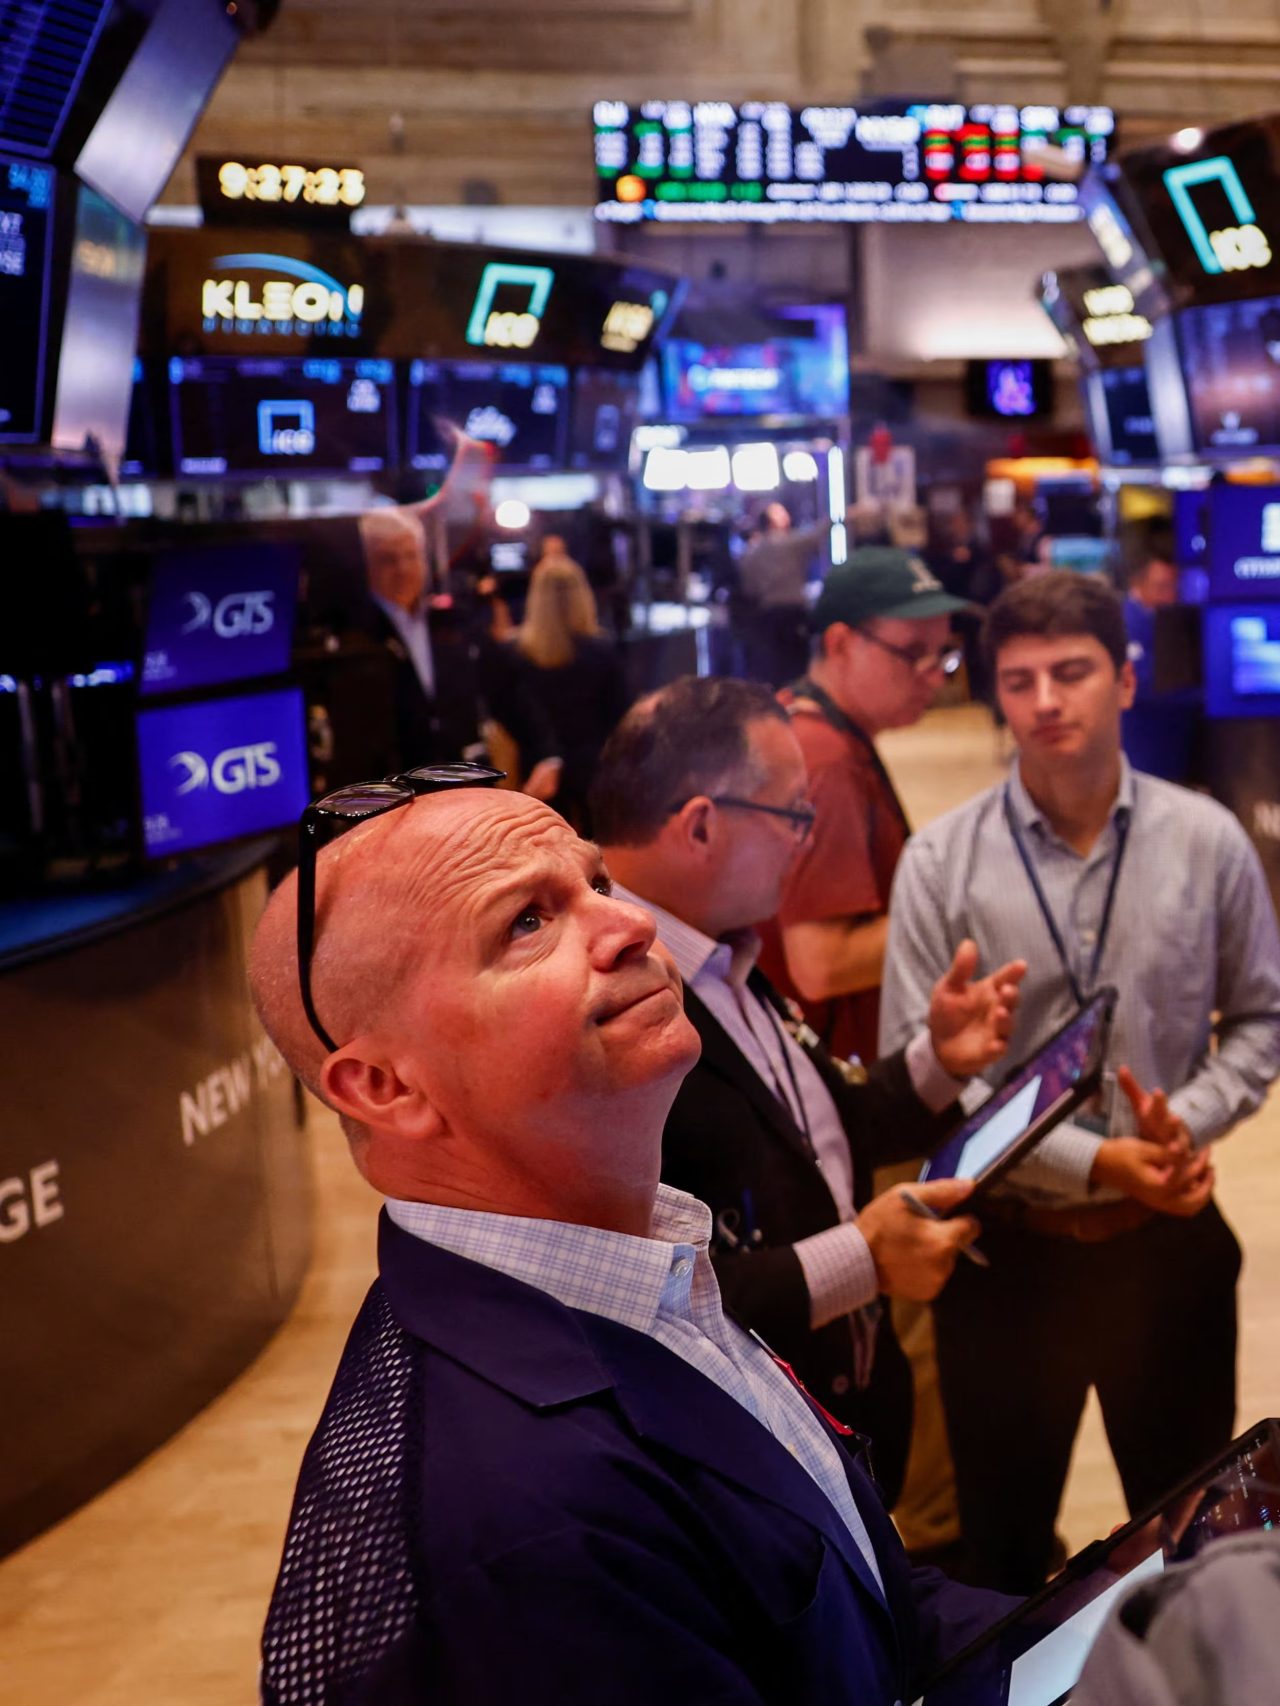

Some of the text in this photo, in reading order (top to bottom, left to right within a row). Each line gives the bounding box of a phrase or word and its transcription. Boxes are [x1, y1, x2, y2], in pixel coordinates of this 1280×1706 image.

[213, 590, 275, 638] GTS
[211, 742, 281, 794] GTS
[180, 1051, 252, 1146] NEW
